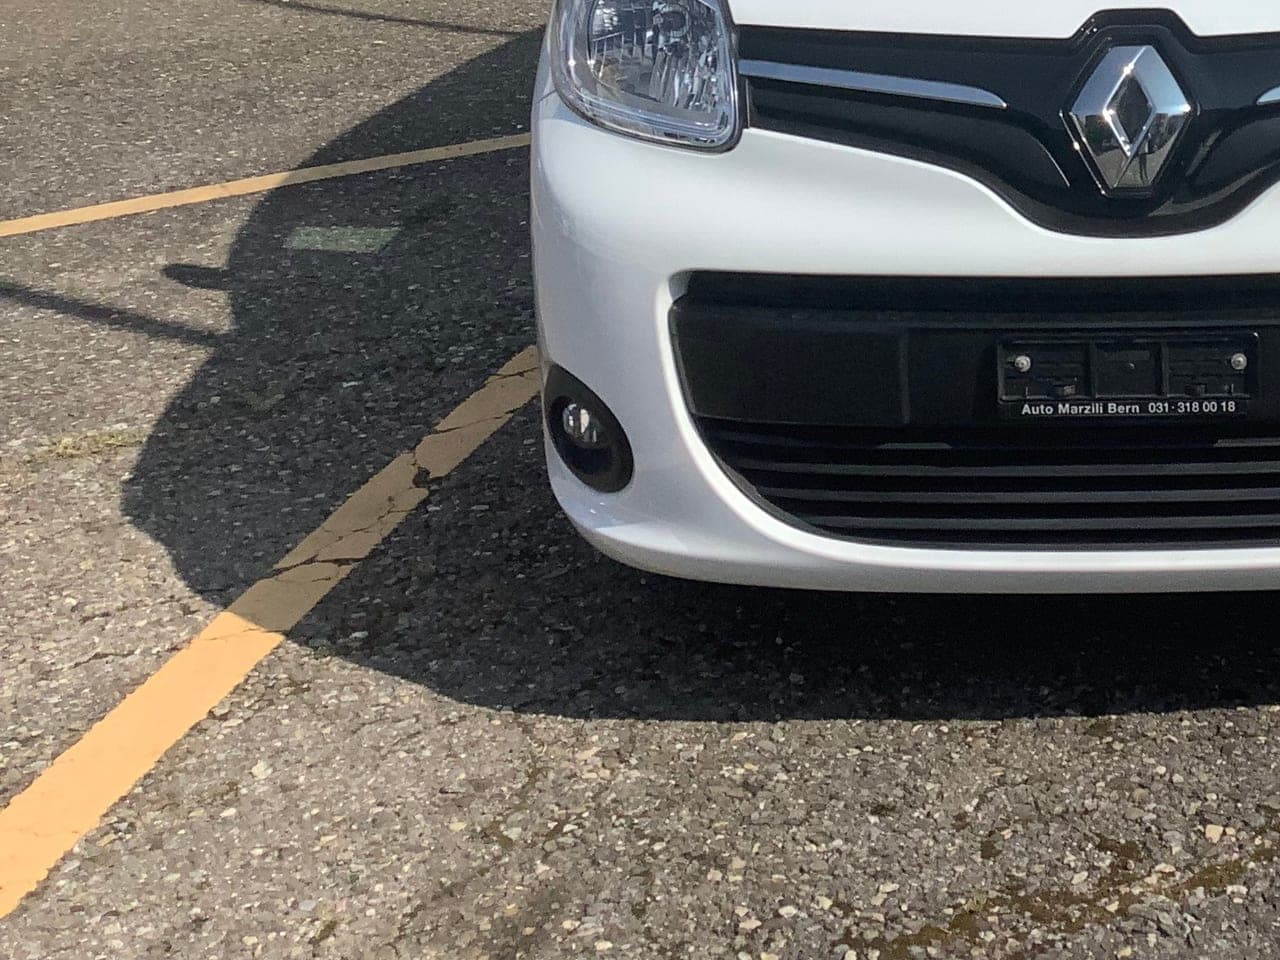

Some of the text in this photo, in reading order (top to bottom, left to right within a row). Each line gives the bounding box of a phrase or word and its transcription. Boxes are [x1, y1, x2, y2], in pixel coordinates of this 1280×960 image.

[1022, 403, 1053, 415] Auto
[1058, 403, 1103, 414] Marzili
[1107, 403, 1140, 414] Bern
[1202, 402, 1217, 412] 00
[1221, 401, 1236, 412] 18
